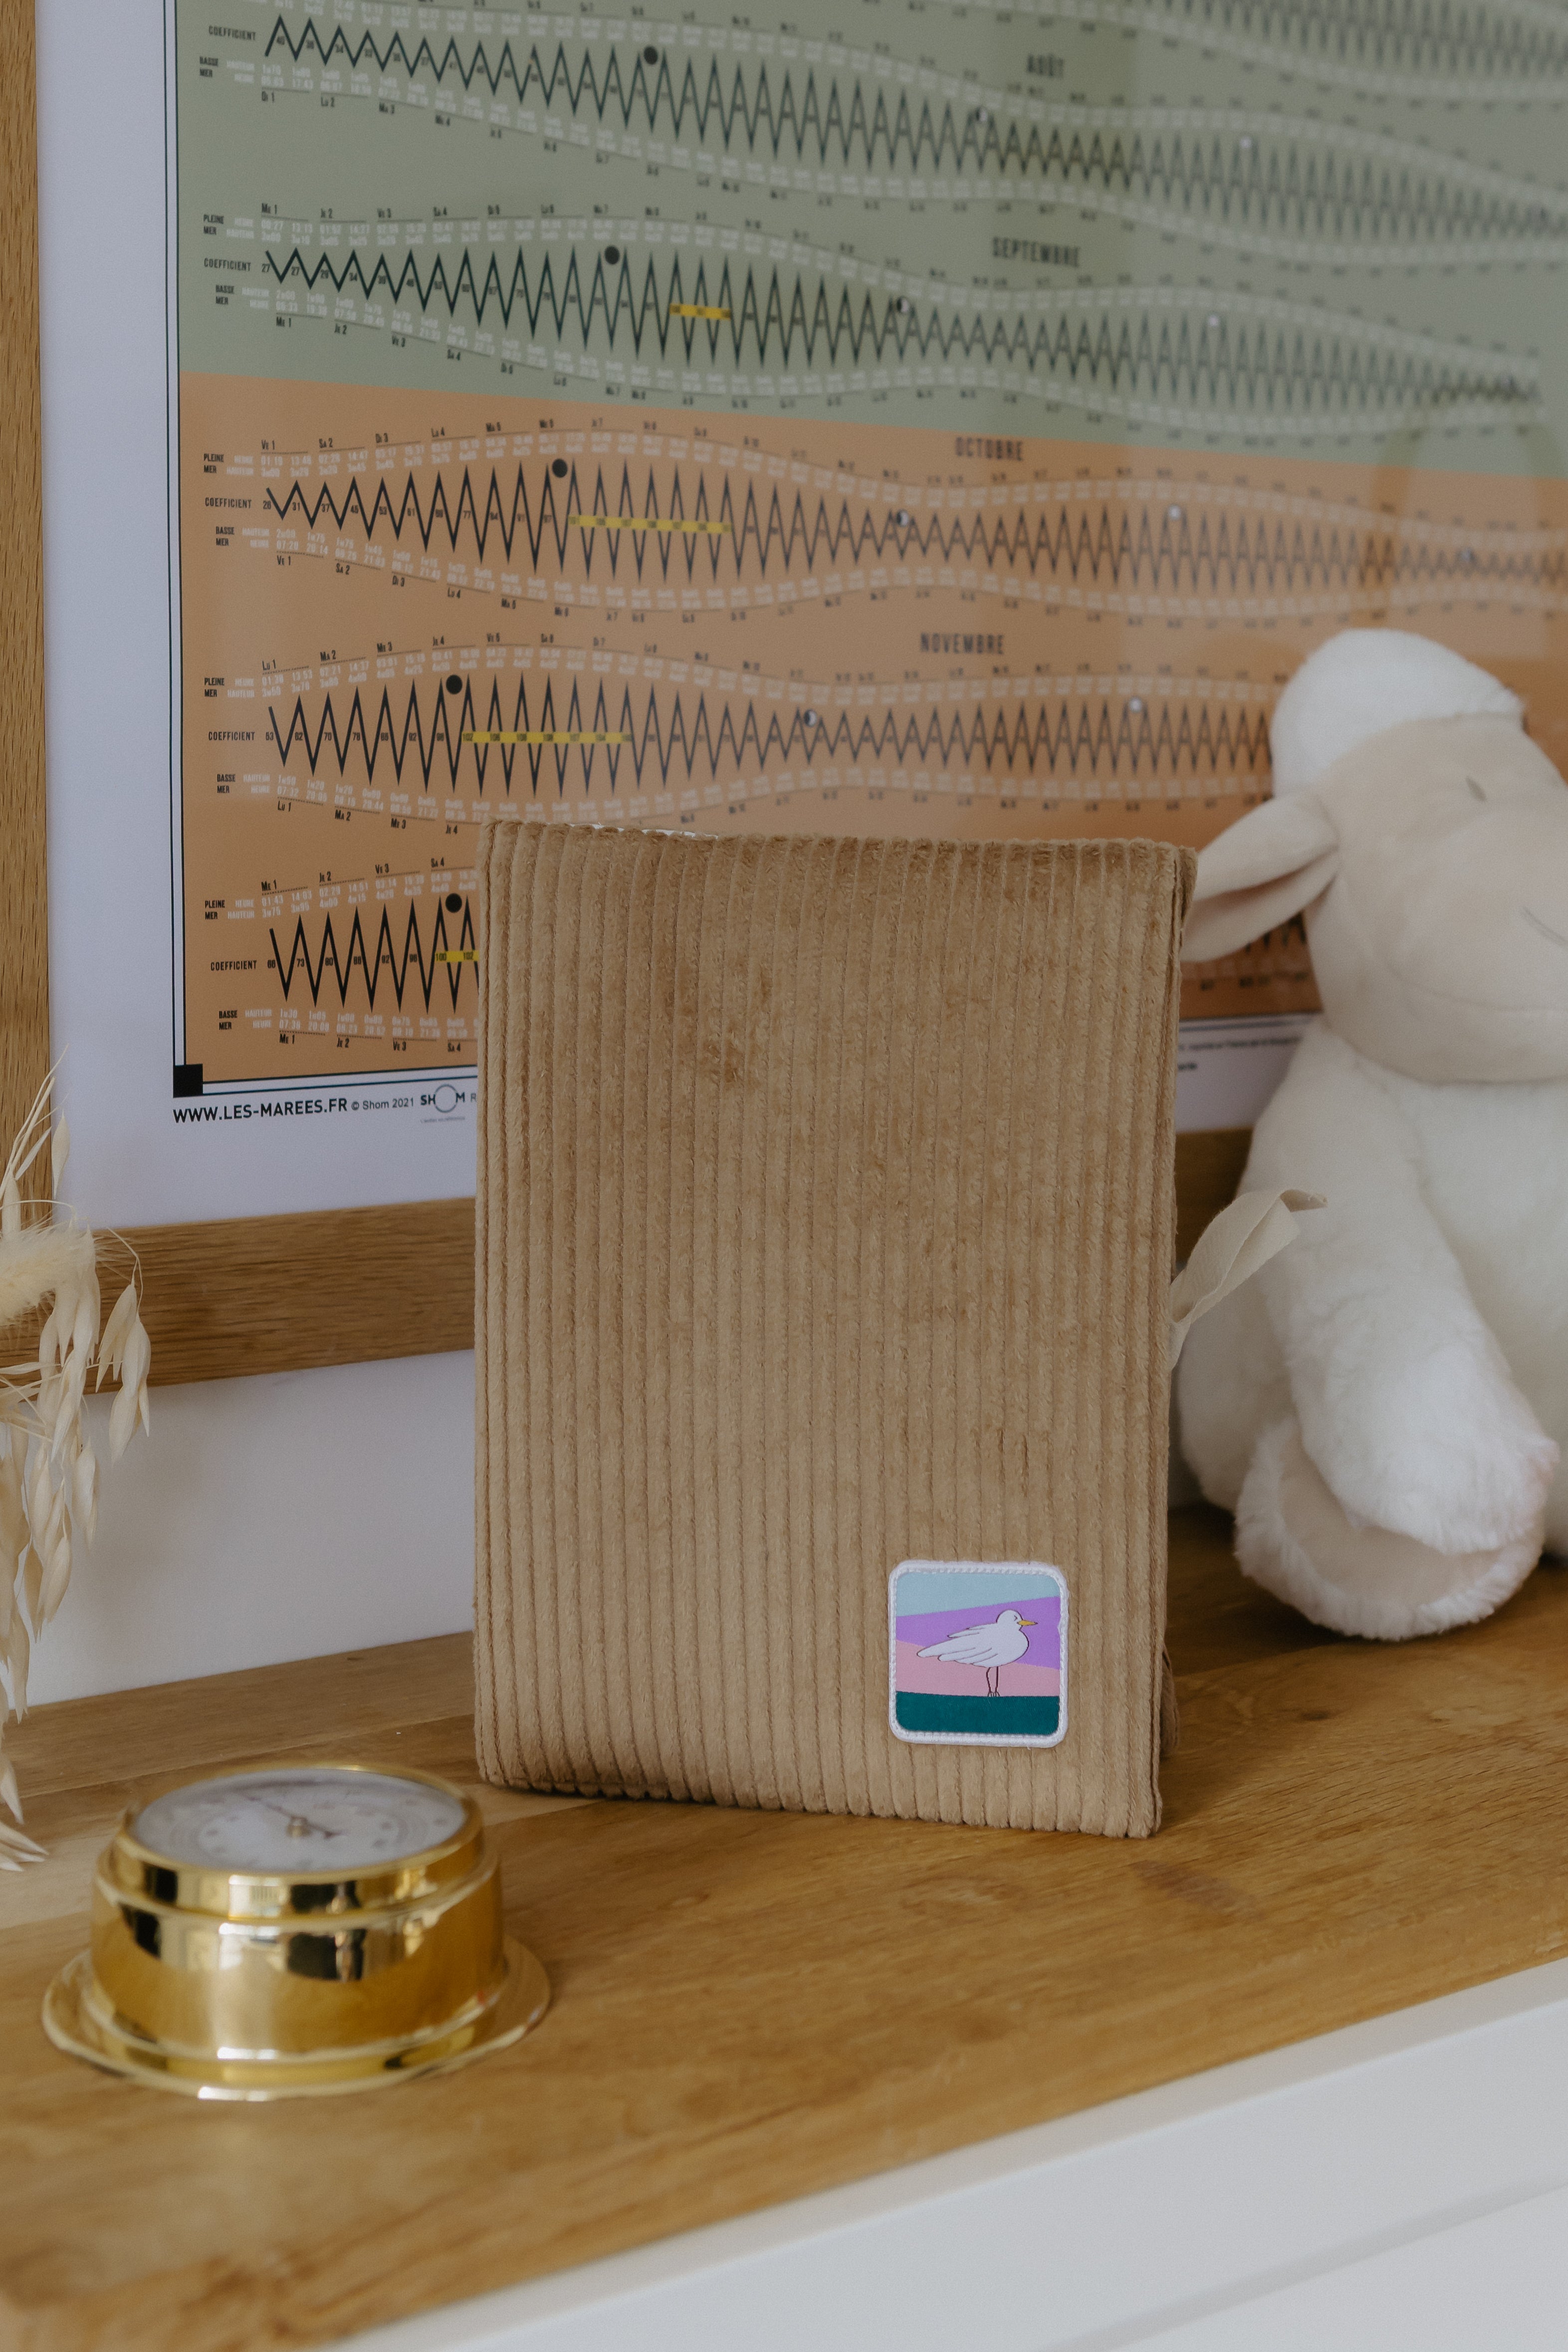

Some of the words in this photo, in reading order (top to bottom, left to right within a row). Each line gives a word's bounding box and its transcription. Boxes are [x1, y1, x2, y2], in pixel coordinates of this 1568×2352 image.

[209, 25, 256, 41] COEFFICIENT
[204, 214, 224, 224] PLEINE
[204, 226, 217, 235] MER
[993, 236, 1080, 268] SEPTEMBRE
[204, 257, 251, 271] COEFFICIENT
[261, 263, 270, 272] 27
[291, 266, 299, 275] 27
[956, 437, 1023, 461] OCTOBRE
[204, 453, 224, 463] PLEINE
[204, 465, 217, 474] MER
[205, 497, 251, 508] COEFFICIENT
[216, 526, 234, 535] BASSE
[920, 633, 1004, 655] NOVEMBRE
[332, 650, 336, 660] 2
[209, 731, 255, 741] COEFFICIENT
[324, 732, 332, 741] 70
[217, 774, 235, 782] BASSE
[346, 812, 351, 821] 2
[327, 871, 331, 882] 2
[211, 960, 257, 971] COEFFICIENT
[297, 958, 304, 967] 73
[219, 1010, 237, 1019] BASSE
[345, 1038, 349, 1048] 2
[173, 1098, 347, 1123] WWW.LES-MAREES.FR
[363, 1100, 389, 1110] Shom
[393, 1097, 414, 1108] 2021
